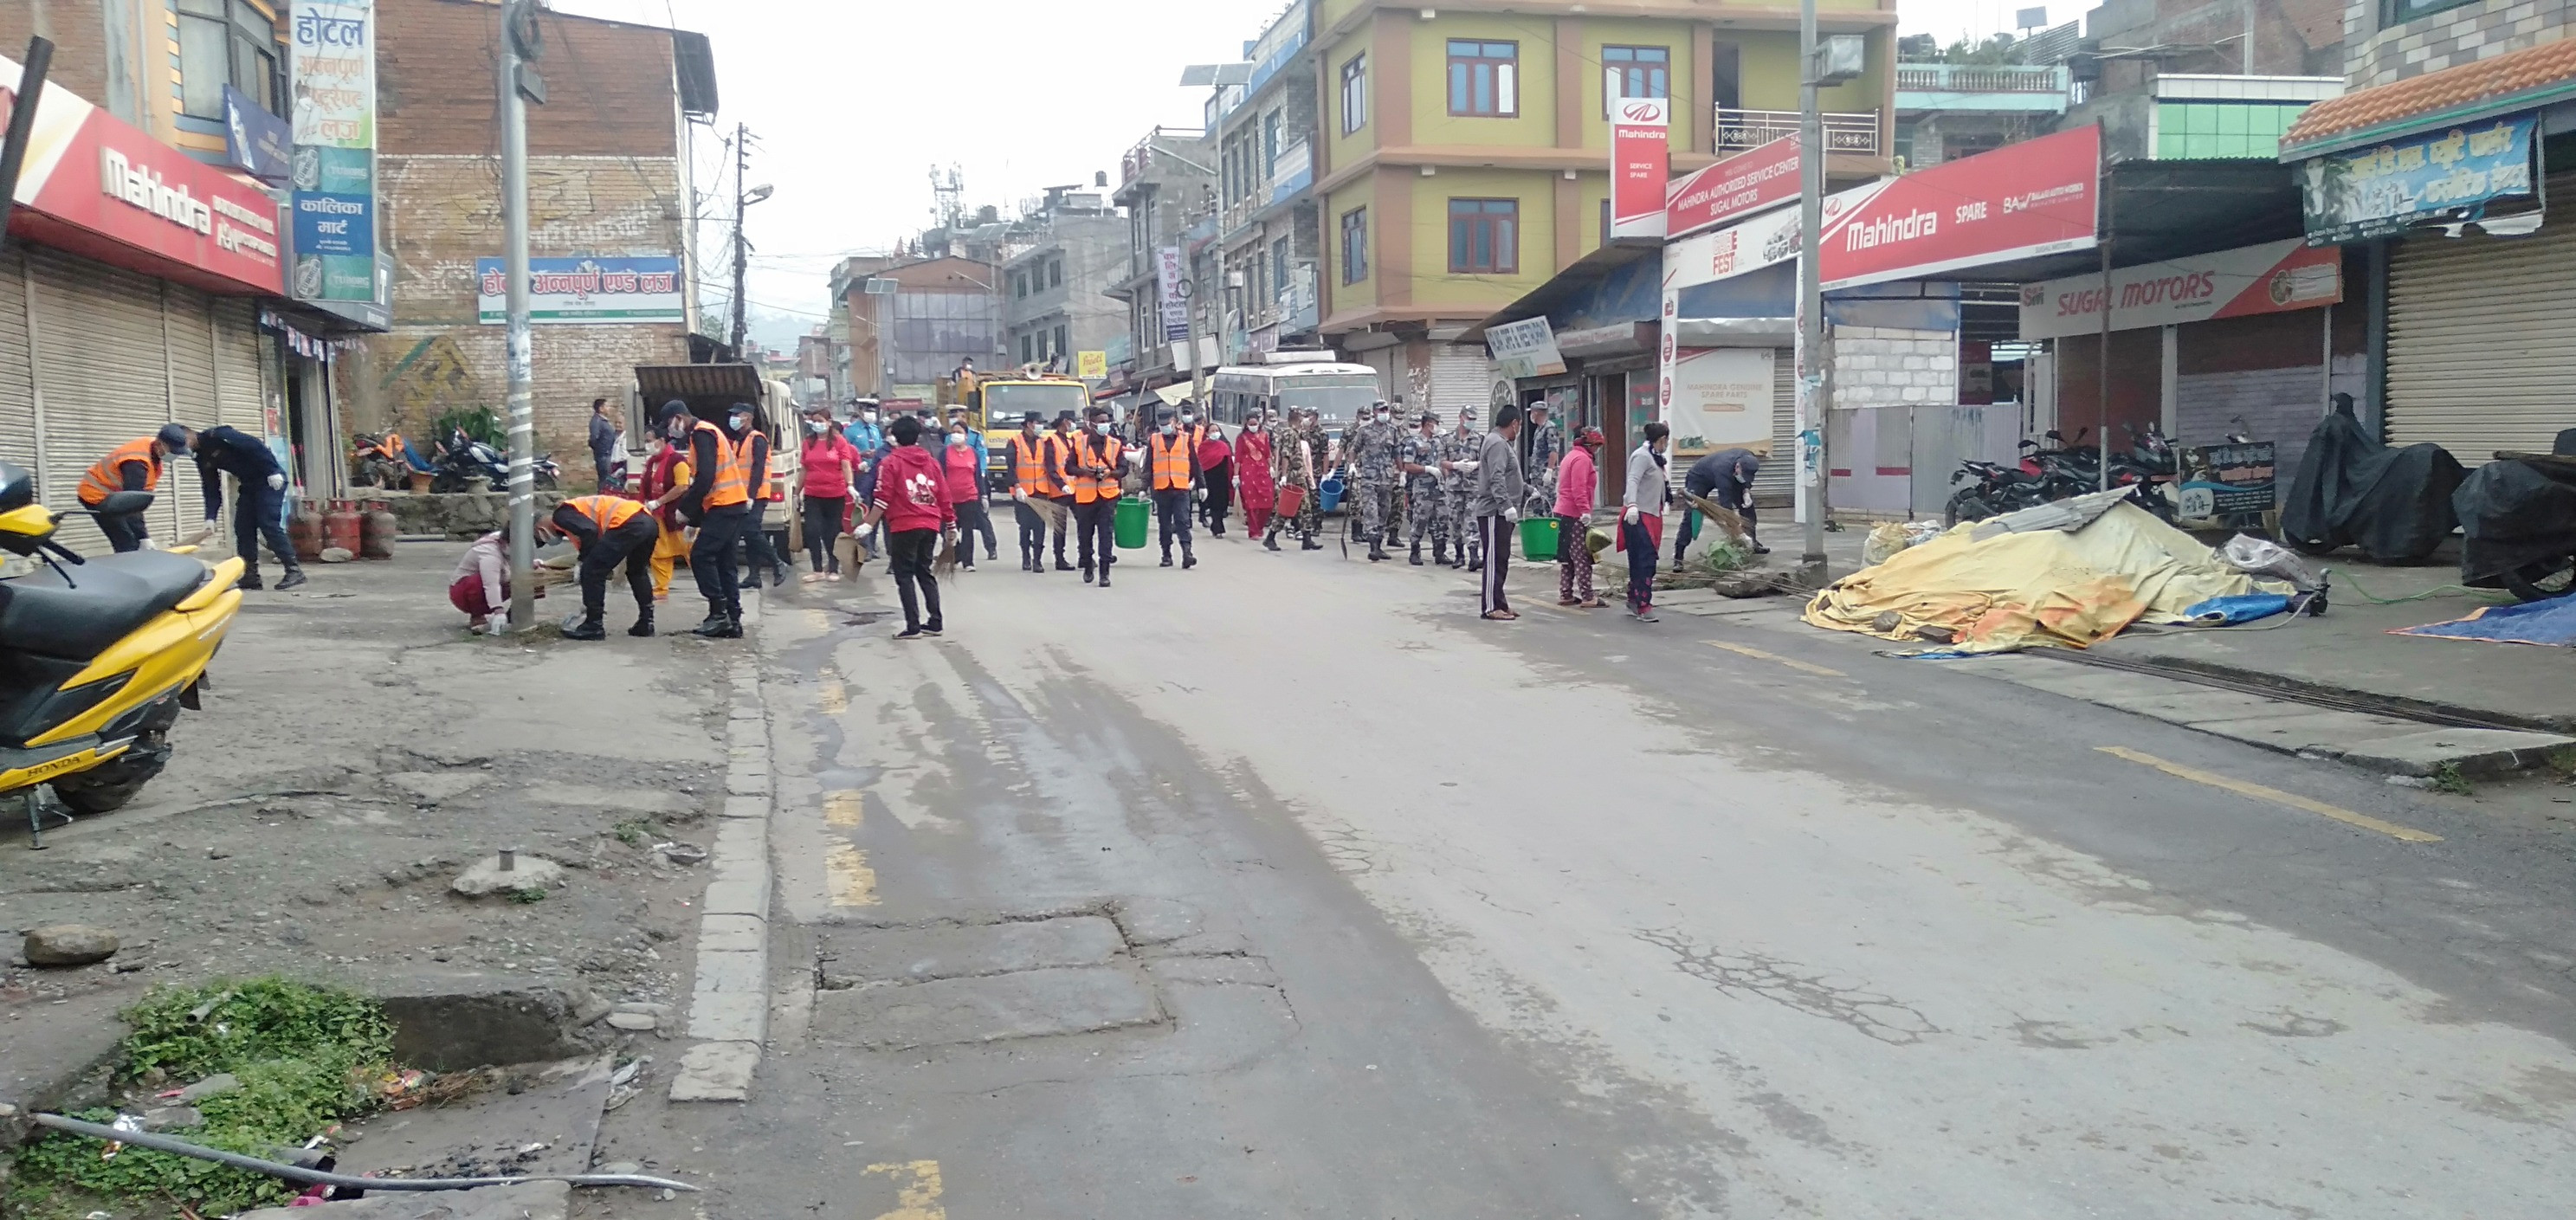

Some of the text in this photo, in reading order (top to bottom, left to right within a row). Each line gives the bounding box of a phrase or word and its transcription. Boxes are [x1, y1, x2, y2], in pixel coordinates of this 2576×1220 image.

[296, 7, 365, 48] होटल
[320, 119, 360, 140] लज
[1618, 129, 1666, 139] Mahindra
[100, 146, 212, 236] Mahindra
[1677, 156, 1799, 212] MAHINDRA AUTHORIZED SERVICE CENTER
[300, 197, 364, 216] कालिका
[1710, 188, 1758, 216] SUGAL MOTORS
[1955, 200, 1987, 224] SPARE
[317, 219, 348, 235] मार्ट
[1846, 208, 1938, 252] Mahindra
[1713, 251, 1736, 276] FEST
[533, 268, 600, 300] अन्नपूर्ण
[603, 271, 638, 294] एण्ड
[641, 271, 674, 294] लज
[2121, 270, 2216, 309] MOTORS
[1731, 383, 1763, 391] GENUINE
[27, 756, 81, 778] HONDA
